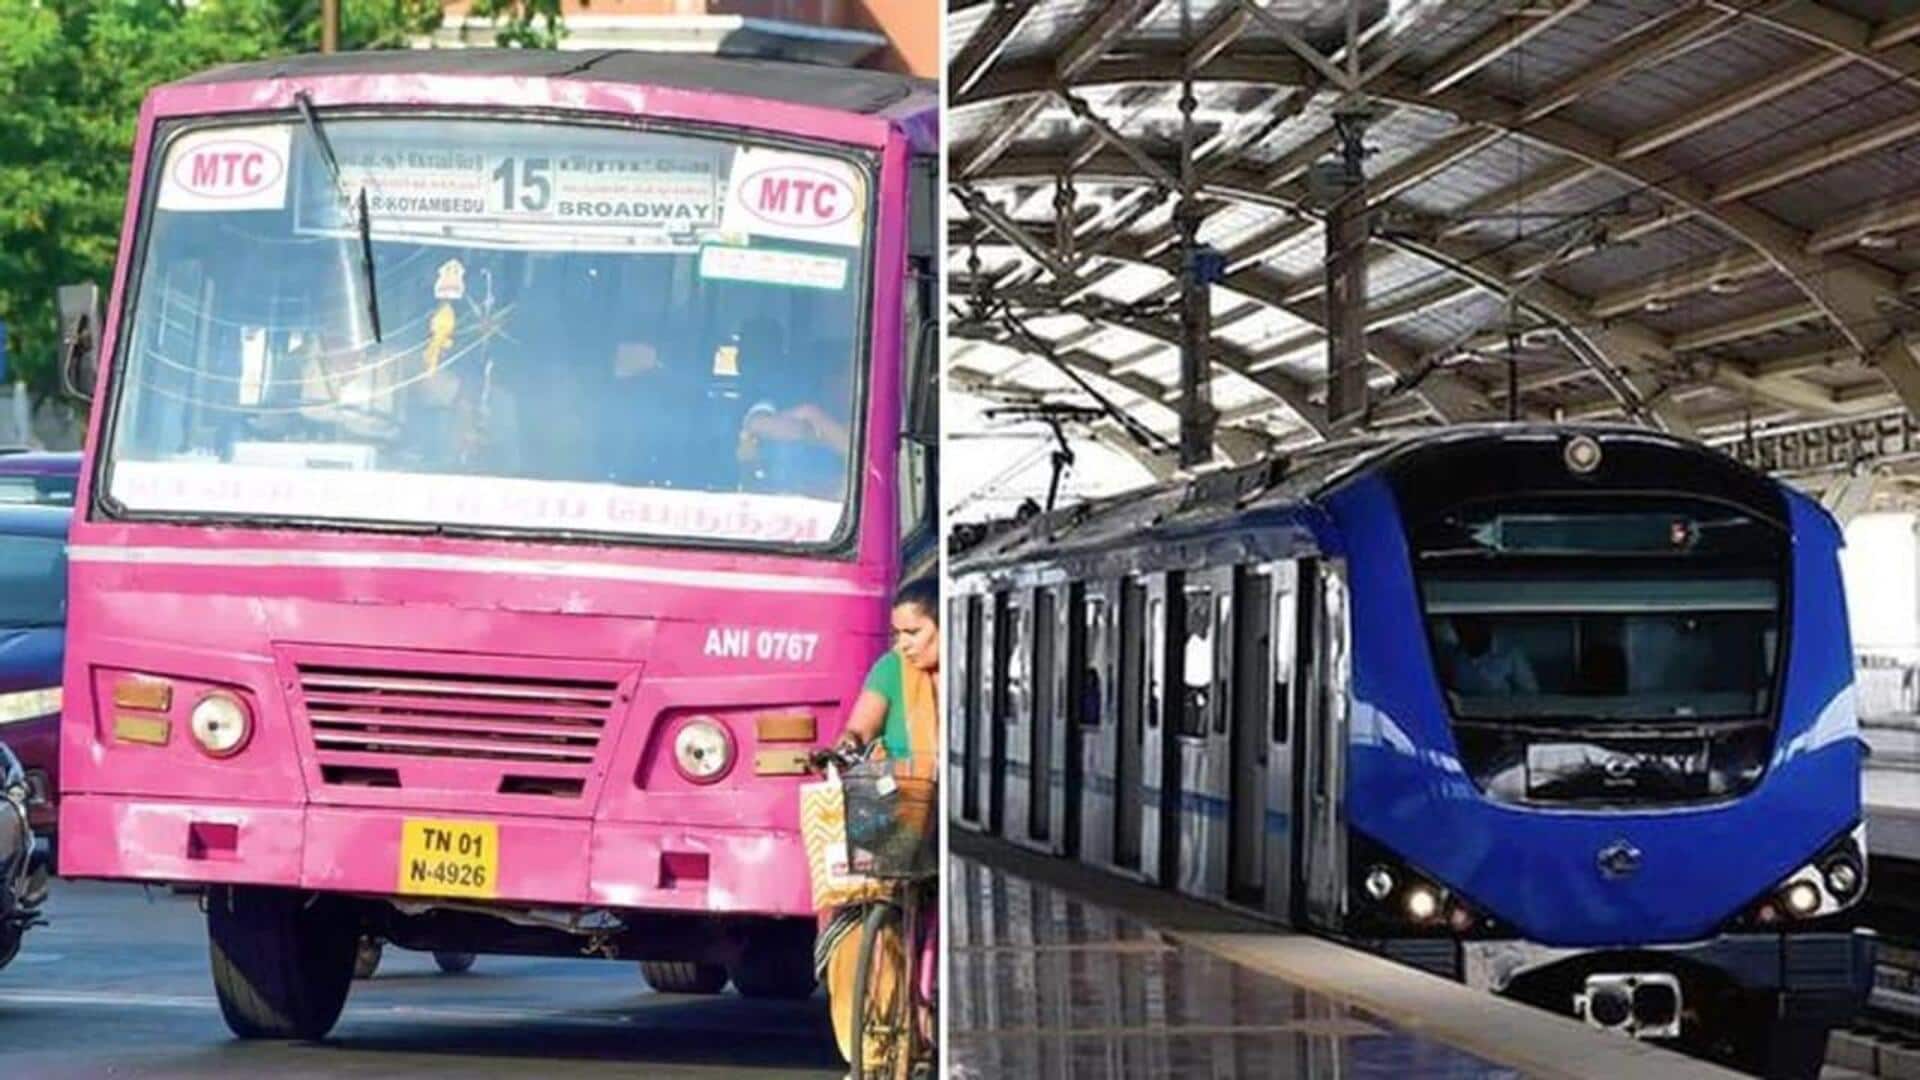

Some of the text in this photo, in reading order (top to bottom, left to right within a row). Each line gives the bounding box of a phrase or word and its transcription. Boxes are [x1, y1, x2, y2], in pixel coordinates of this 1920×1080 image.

[191, 152, 263, 187] MTC
[493, 157, 551, 212] 15
[558, 200, 709, 219] BROADWAY
[759, 177, 838, 218] MTC
[704, 628, 819, 662] ANI 0767
[423, 827, 483, 858] TN 01
[410, 858, 486, 888] N-4926
